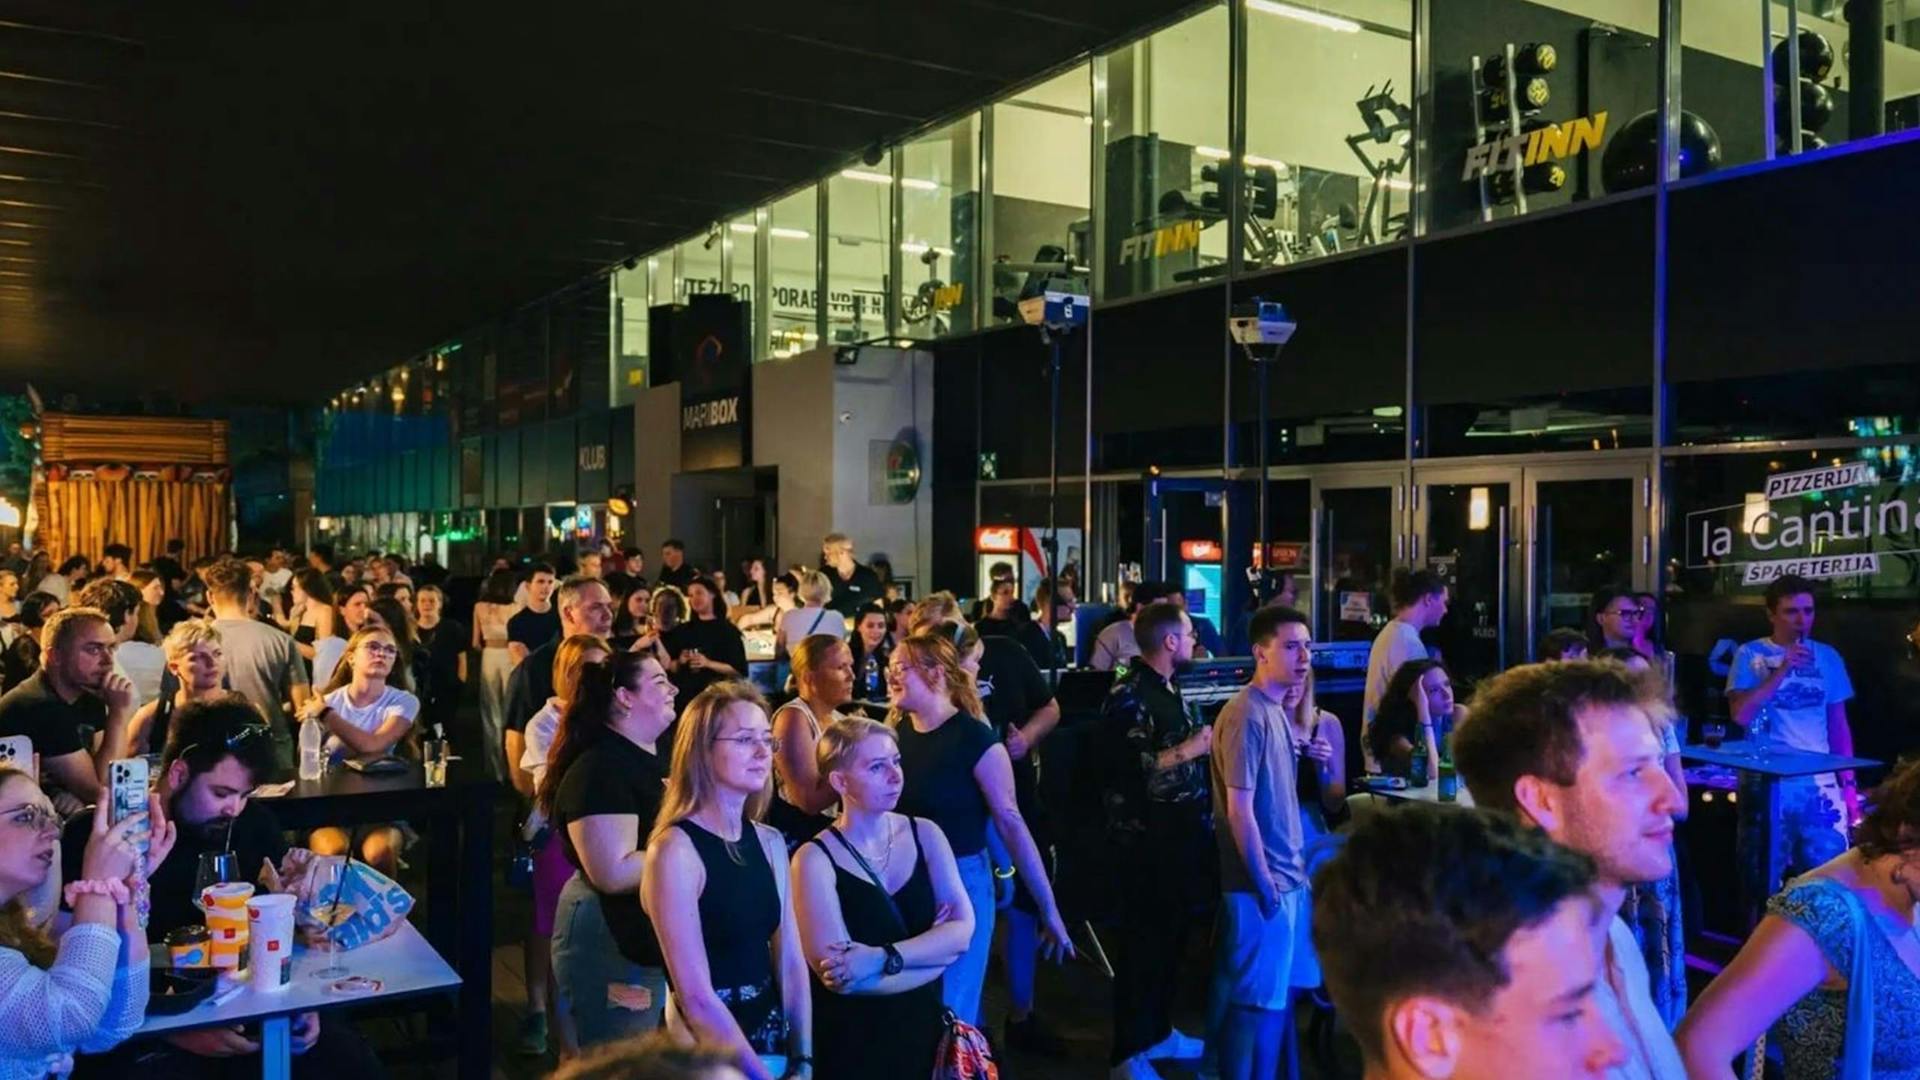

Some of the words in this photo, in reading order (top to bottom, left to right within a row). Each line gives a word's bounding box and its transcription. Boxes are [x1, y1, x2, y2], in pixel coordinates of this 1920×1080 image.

[1462, 111, 1607, 181] FITINN
[1119, 220, 1201, 265] FITINN
[683, 397, 738, 430] MARIBOX
[579, 445, 606, 471] KLUB
[1702, 520, 1732, 558] la
[1749, 555, 1874, 581] SPAGETERIJA
